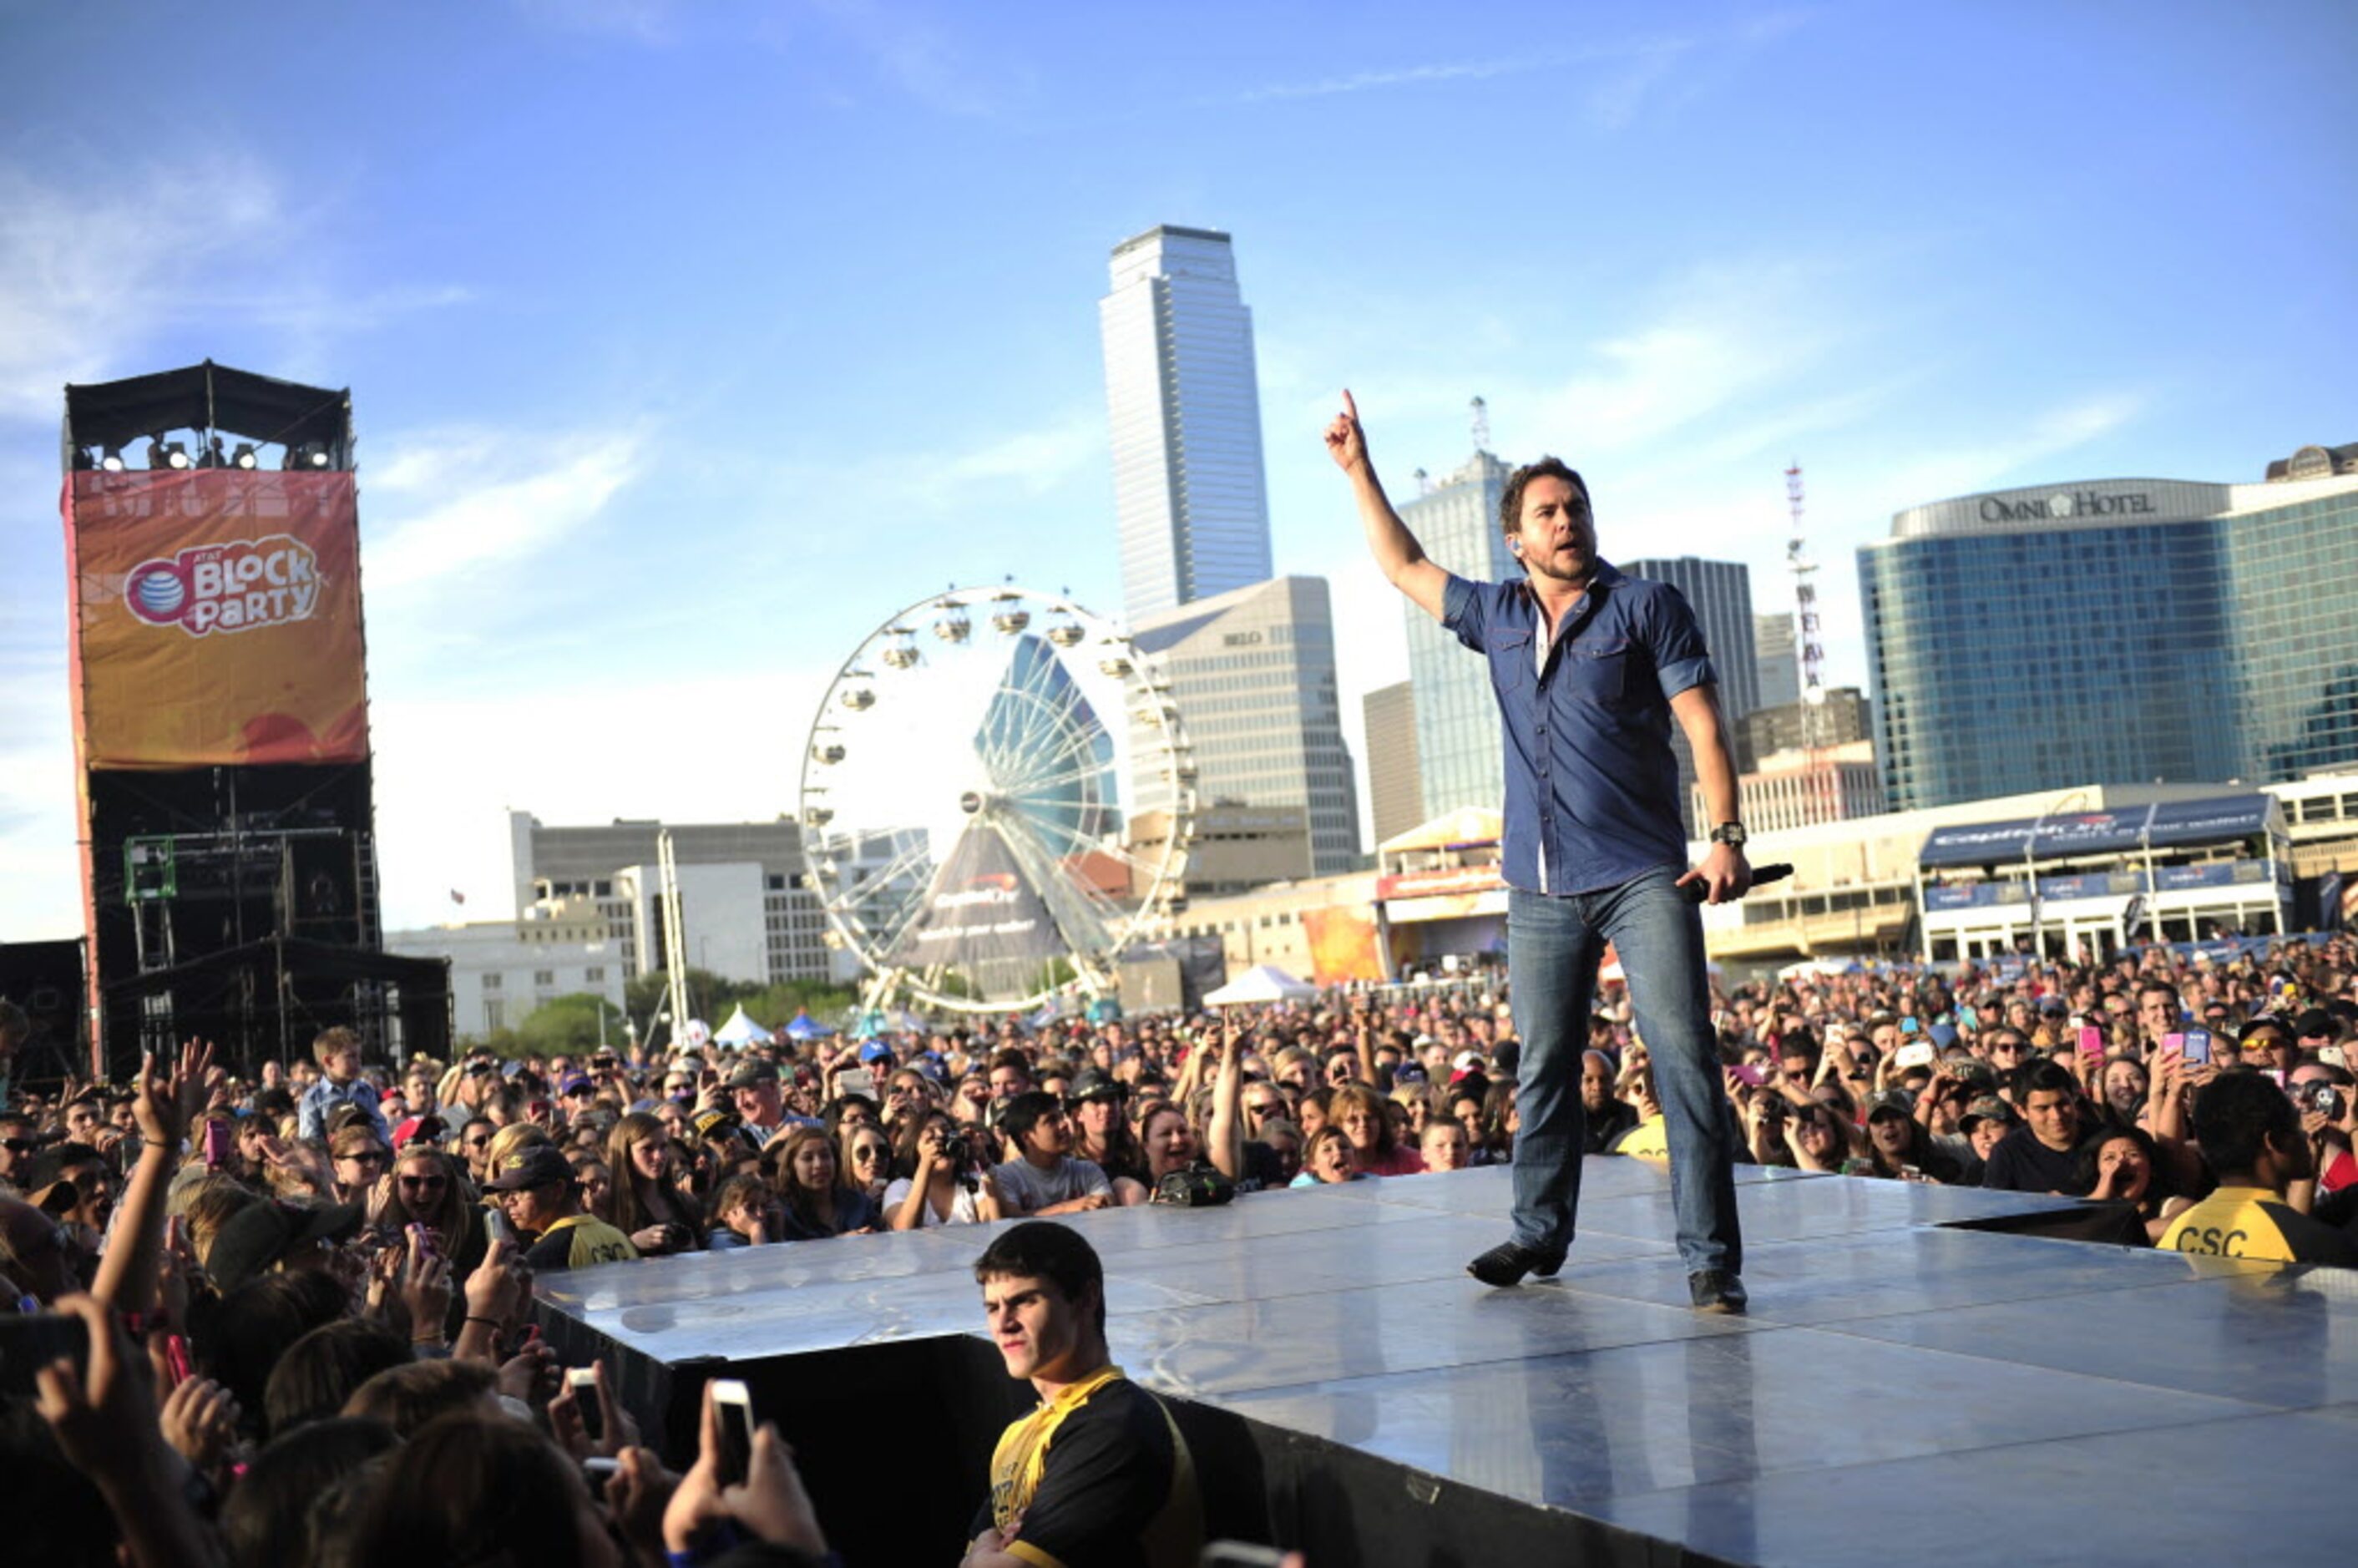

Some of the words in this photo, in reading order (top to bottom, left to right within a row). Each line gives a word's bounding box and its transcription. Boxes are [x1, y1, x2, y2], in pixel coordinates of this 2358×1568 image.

[1980, 496, 2046, 522] OMNI
[2074, 491, 2156, 516] HOTEL
[2176, 1226, 2248, 1258] CSC
